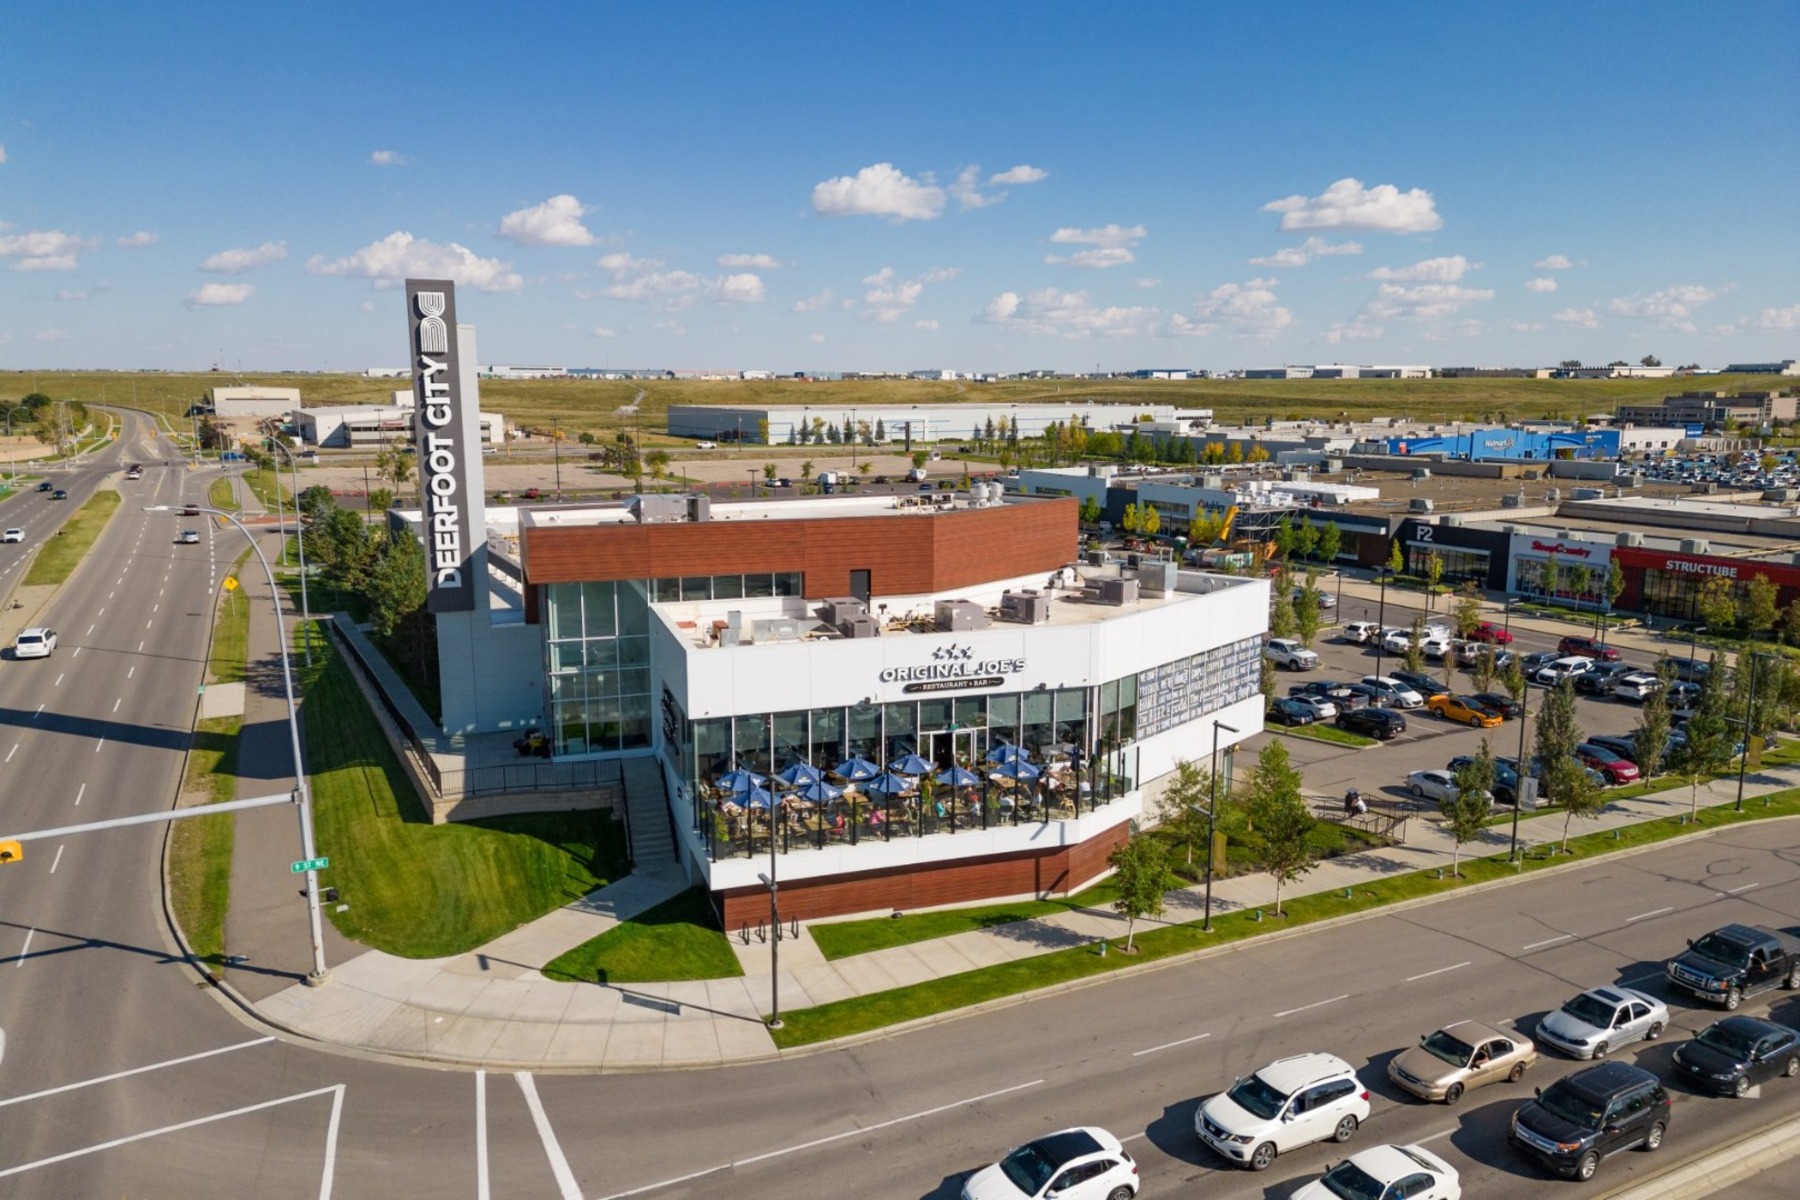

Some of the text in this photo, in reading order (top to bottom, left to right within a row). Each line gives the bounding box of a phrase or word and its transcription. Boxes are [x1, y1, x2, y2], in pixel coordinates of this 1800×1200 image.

[421, 355, 462, 588] DEERFOOT CITY
[1416, 525, 1433, 541] F2
[1665, 559, 1738, 578] STRUCTUBE
[879, 658, 1027, 682] ORIGINAL JOE'S
[922, 679, 988, 690] RESTAURANT BAR
